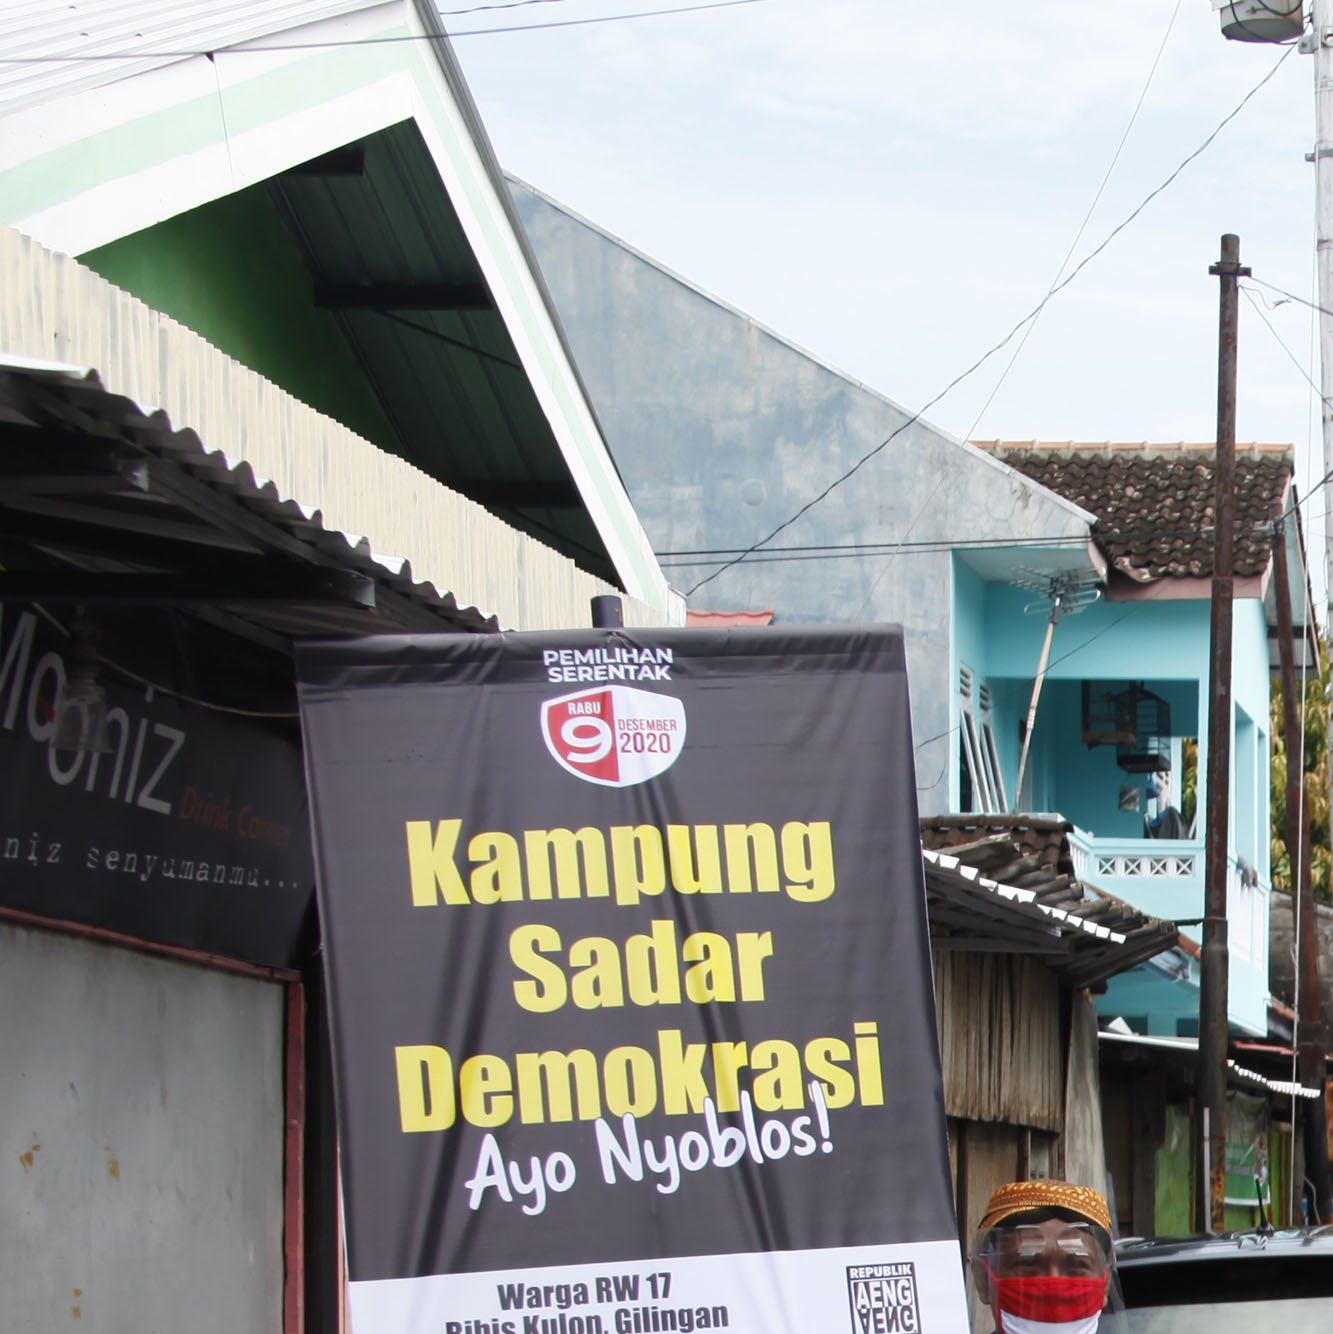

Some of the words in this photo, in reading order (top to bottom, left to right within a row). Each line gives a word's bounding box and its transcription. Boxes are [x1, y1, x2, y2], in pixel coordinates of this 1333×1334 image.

[543, 647, 673, 666] PEMILIHAN
[548, 664, 672, 683] SERENTAK
[567, 701, 602, 715] RABU
[560, 715, 613, 763] 9
[617, 718, 677, 731] DESEMBER
[620, 732, 671, 753] 2020
[405, 818, 836, 907] Kampung
[508, 919, 774, 1013] Sadar
[394, 1021, 885, 1133] Demokrasi
[464, 1132, 576, 1215] Ayo
[594, 1079, 834, 1194] Nyoblos!
[849, 1263, 912, 1279] REPUBLIK
[497, 1282, 589, 1311] Warga
[595, 1274, 639, 1303] RW
[645, 1271, 671, 1299] 17
[856, 1279, 912, 1309] AENG
[614, 1304, 729, 1334] Gilingan
